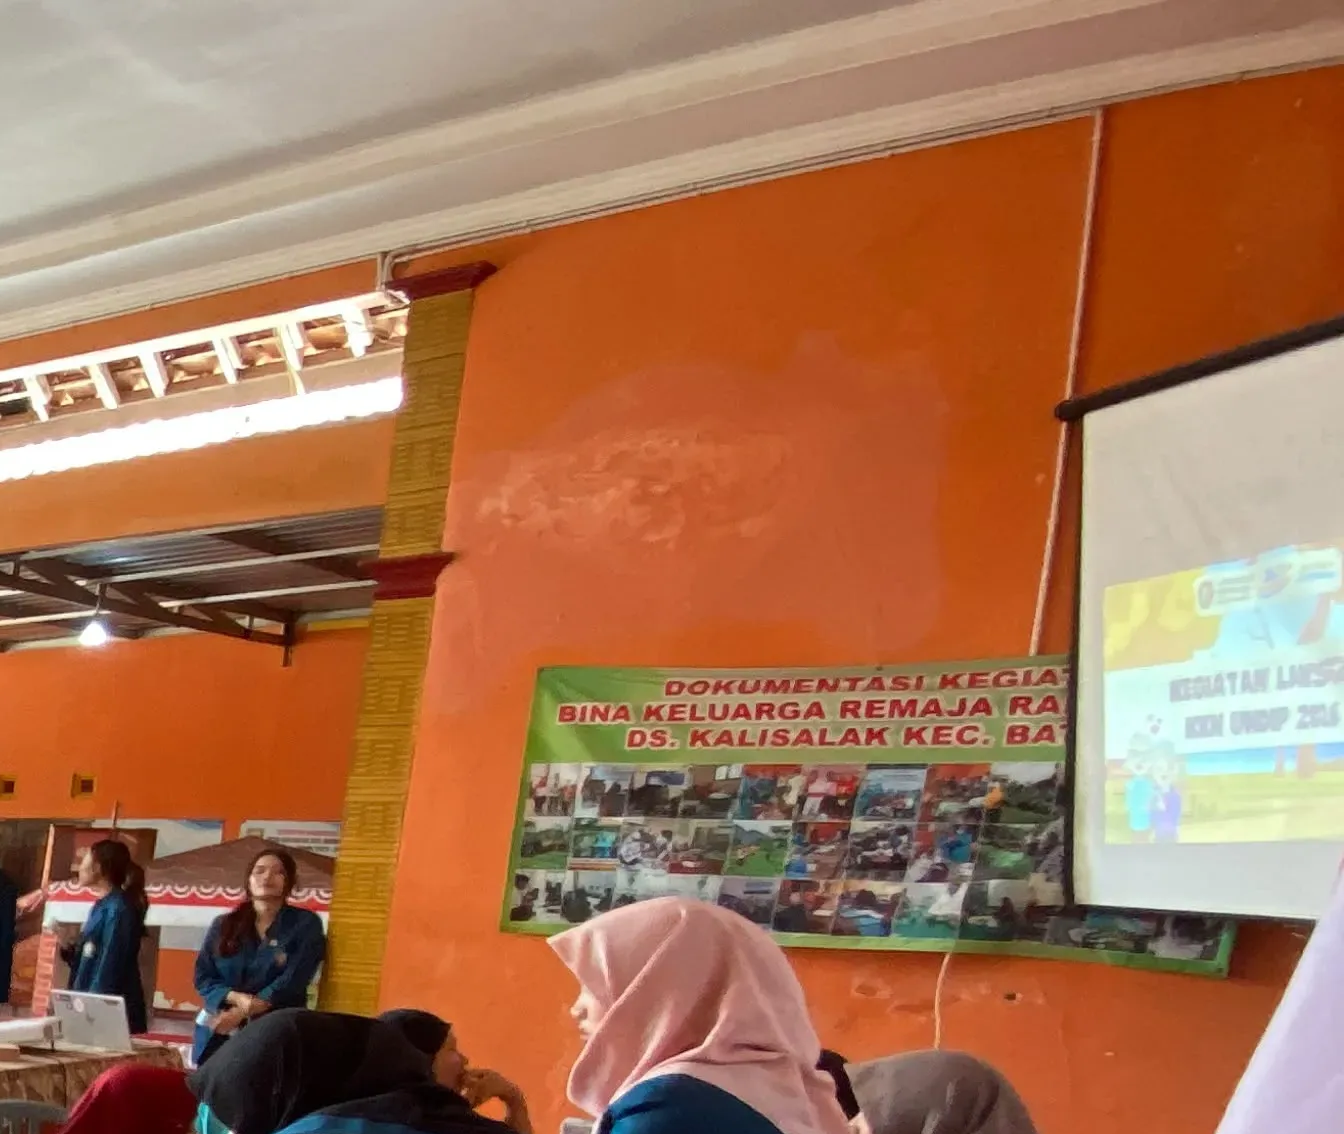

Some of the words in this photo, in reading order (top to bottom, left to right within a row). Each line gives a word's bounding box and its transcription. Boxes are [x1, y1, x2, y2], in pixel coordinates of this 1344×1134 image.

[664, 675, 925, 697] DOKUMENTASI
[557, 704, 632, 723] BINA
[642, 701, 826, 722] KELUARGA
[838, 697, 993, 719] REMAJA
[1008, 695, 1067, 716] RA
[627, 728, 677, 748] DS.
[688, 727, 891, 747] KALISALAK
[902, 725, 991, 746] KEC.
[1006, 724, 1068, 745] BA
